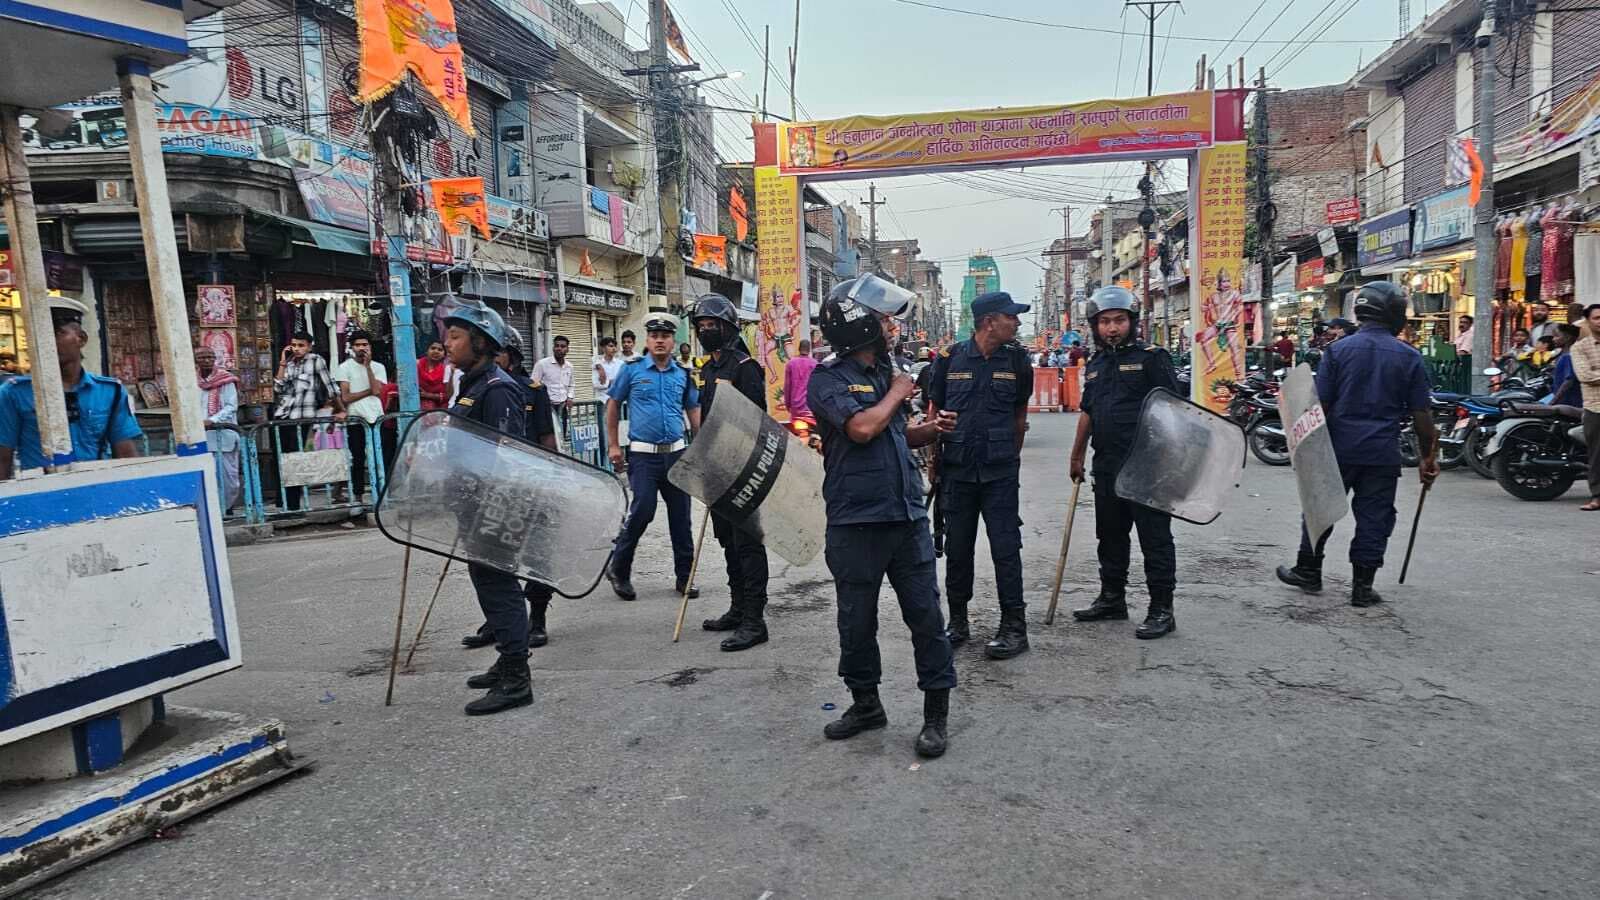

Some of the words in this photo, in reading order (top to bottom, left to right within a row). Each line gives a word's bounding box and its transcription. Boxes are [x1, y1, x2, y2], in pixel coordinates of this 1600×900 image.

[260, 67, 297, 110] LG
[536, 132, 575, 145] AFFORDABLE
[825, 129, 840, 145] श्री
[842, 128, 885, 147] हनुमान
[889, 122, 945, 142] जन्मोत्सव
[948, 118, 977, 135] शोभा
[981, 116, 1024, 132] यात्रामा
[1124, 103, 1189, 123] सनातनीमा
[547, 143, 565, 153] COST
[926, 137, 964, 156] हार्दिक
[968, 133, 1030, 154] अभिनन्दन
[457, 150, 477, 178] LG
[1293, 405, 1323, 440] POLICE
[731, 471, 766, 509] NEPAL
[756, 430, 781, 474] POLICE
